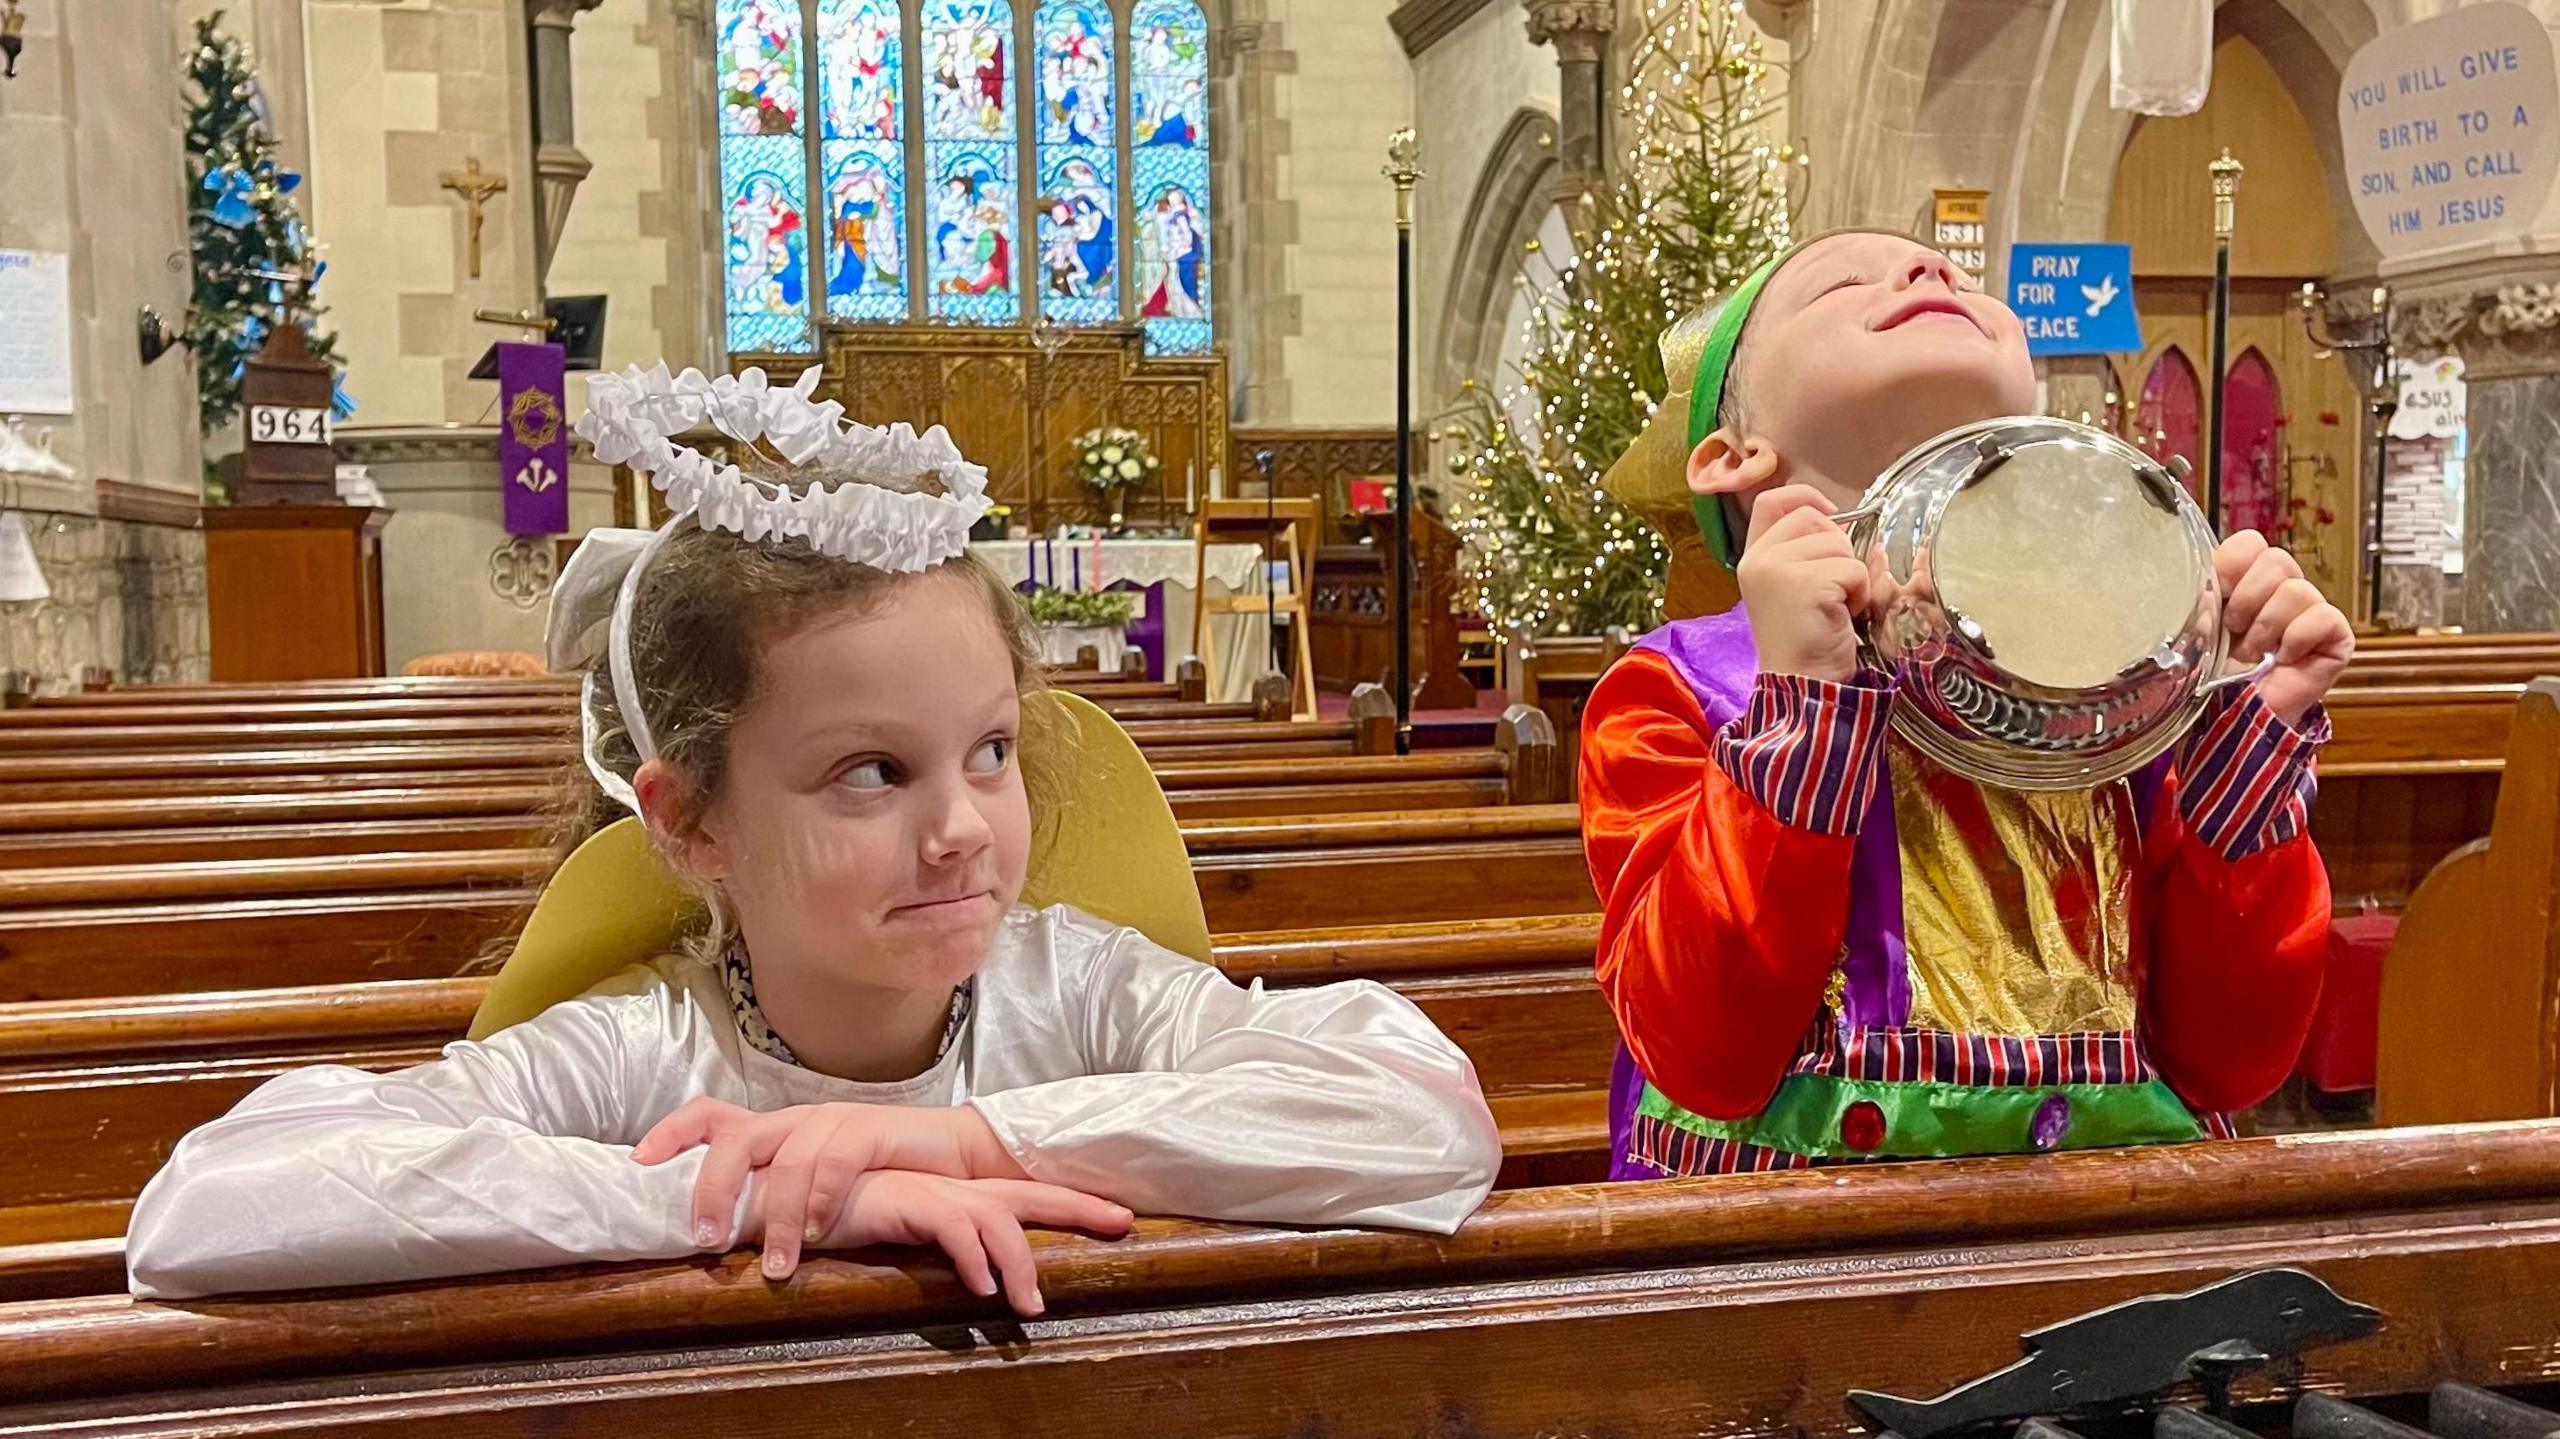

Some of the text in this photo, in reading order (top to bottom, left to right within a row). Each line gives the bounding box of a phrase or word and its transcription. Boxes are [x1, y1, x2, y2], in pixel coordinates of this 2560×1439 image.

[2349, 47, 2518, 111] YOU WILL GIVE
[2379, 104, 2529, 150] BIRTH TO A
[2361, 152, 2521, 195] SON AND CALL
[2389, 195, 2505, 235] HIM JESUS
[2032, 256, 2081, 278] PRAY
[2017, 283, 2056, 305] FOR
[2022, 317, 2079, 338] EACE
[258, 409, 325, 441] 964
